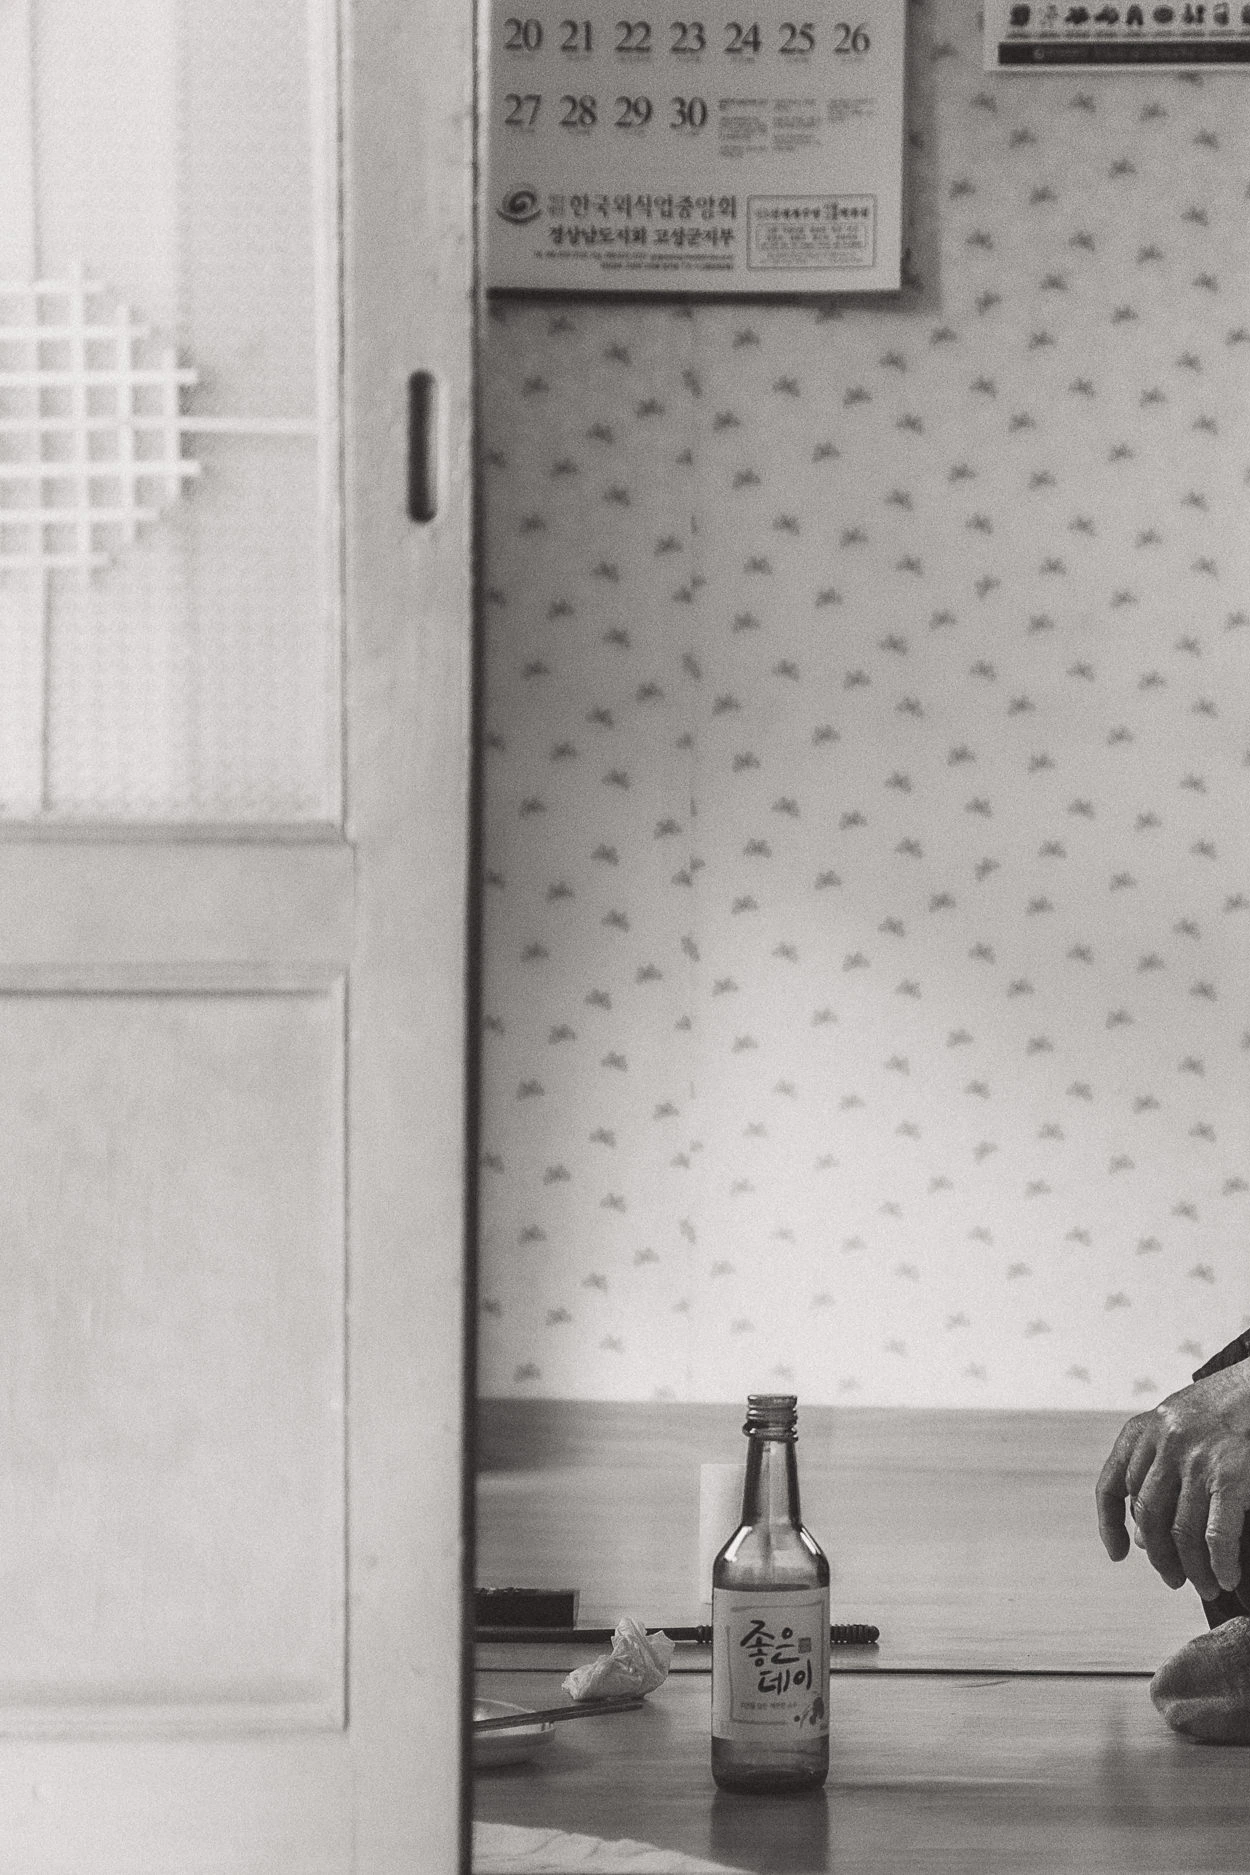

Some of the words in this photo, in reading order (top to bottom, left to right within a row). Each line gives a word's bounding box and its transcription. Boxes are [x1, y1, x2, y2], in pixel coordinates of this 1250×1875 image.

[505, 18, 544, 51] 20
[560, 19, 593, 53] 21
[615, 20, 652, 54] 22
[670, 21, 707, 55] 23
[724, 21, 762, 55] 24
[779, 22, 816, 55] 25
[834, 22, 871, 55] 26
[504, 93, 542, 127] 27
[560, 95, 597, 128] 28
[615, 96, 653, 129] 29
[671, 96, 708, 129] 30
[569, 194, 736, 219] 한국외식업중앙회
[740, 1620, 800, 1667] 좋은
[758, 1659, 812, 1695] 데이
